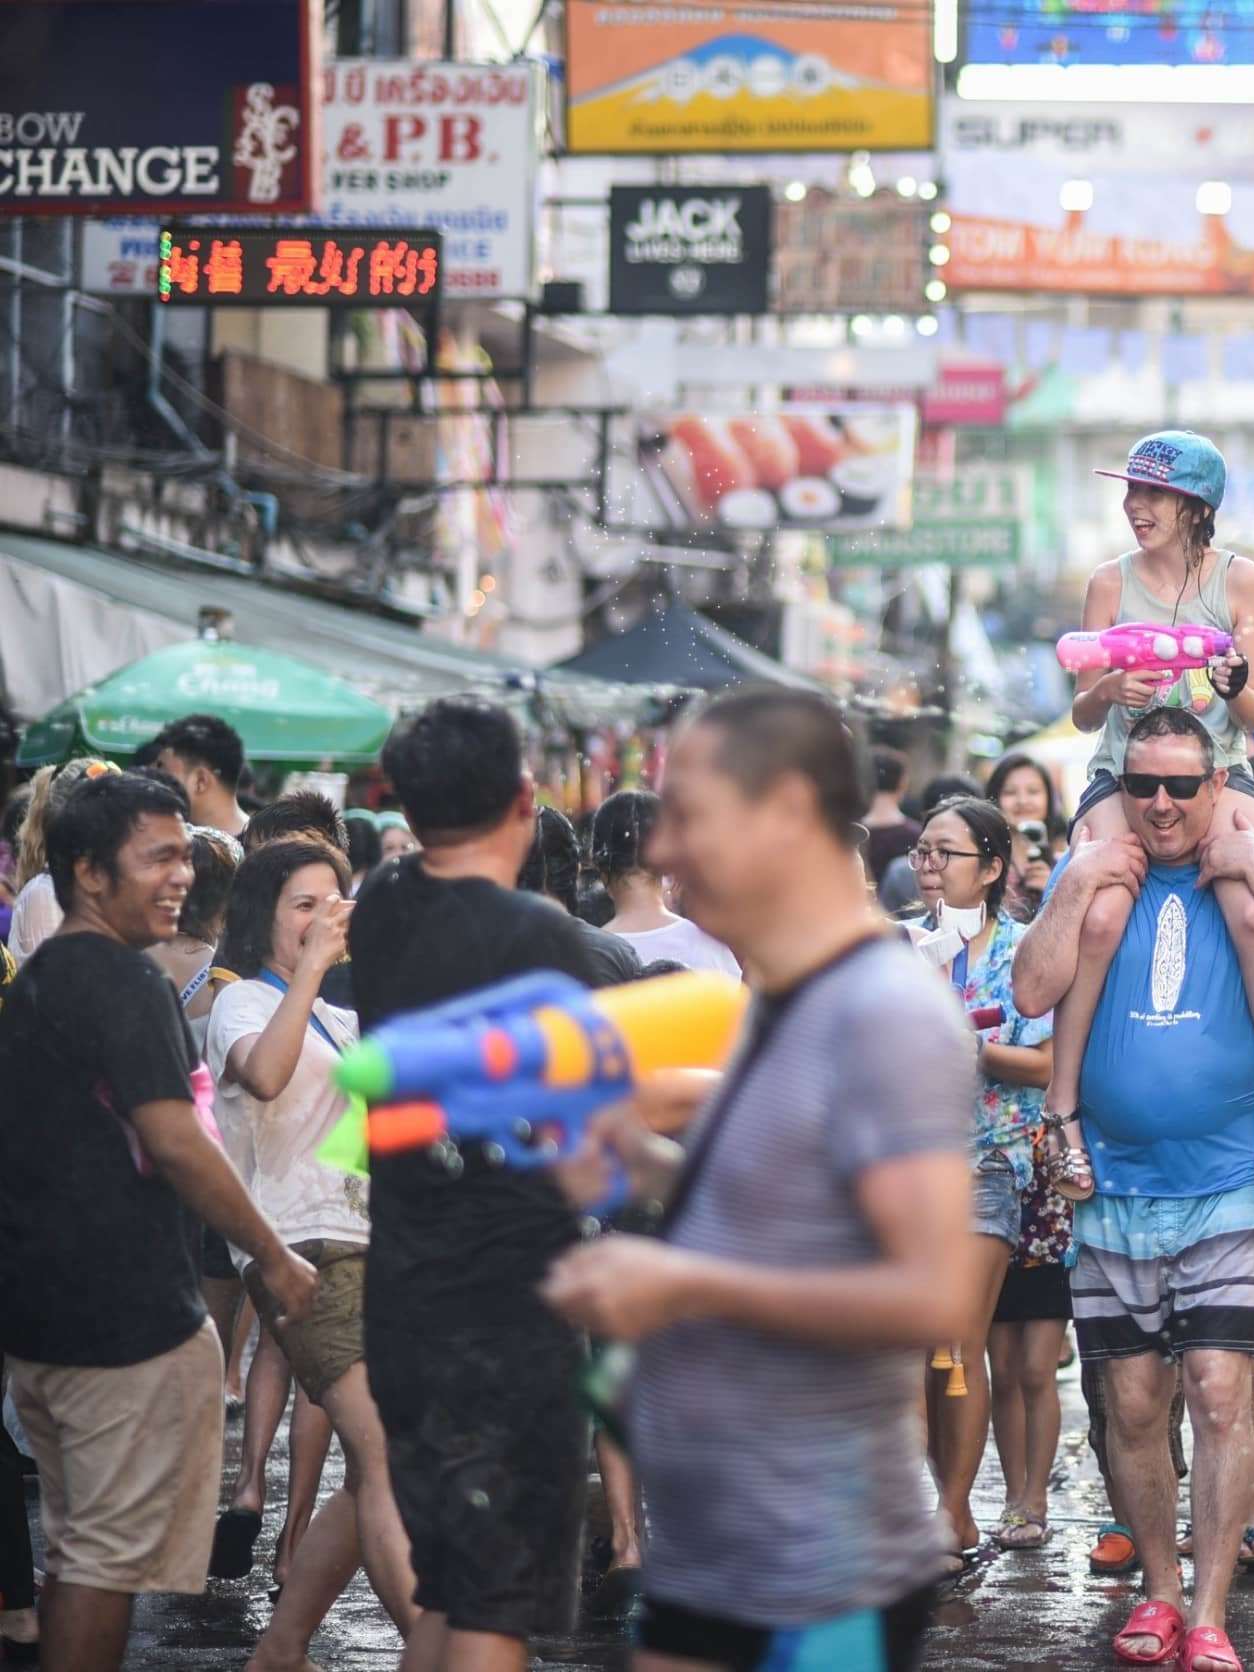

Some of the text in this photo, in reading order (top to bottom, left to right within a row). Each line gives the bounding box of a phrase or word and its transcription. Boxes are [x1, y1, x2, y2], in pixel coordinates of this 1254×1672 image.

[0, 146, 219, 196] HANGE
[624, 197, 743, 243] JACK
[266, 239, 438, 296] 最好的
